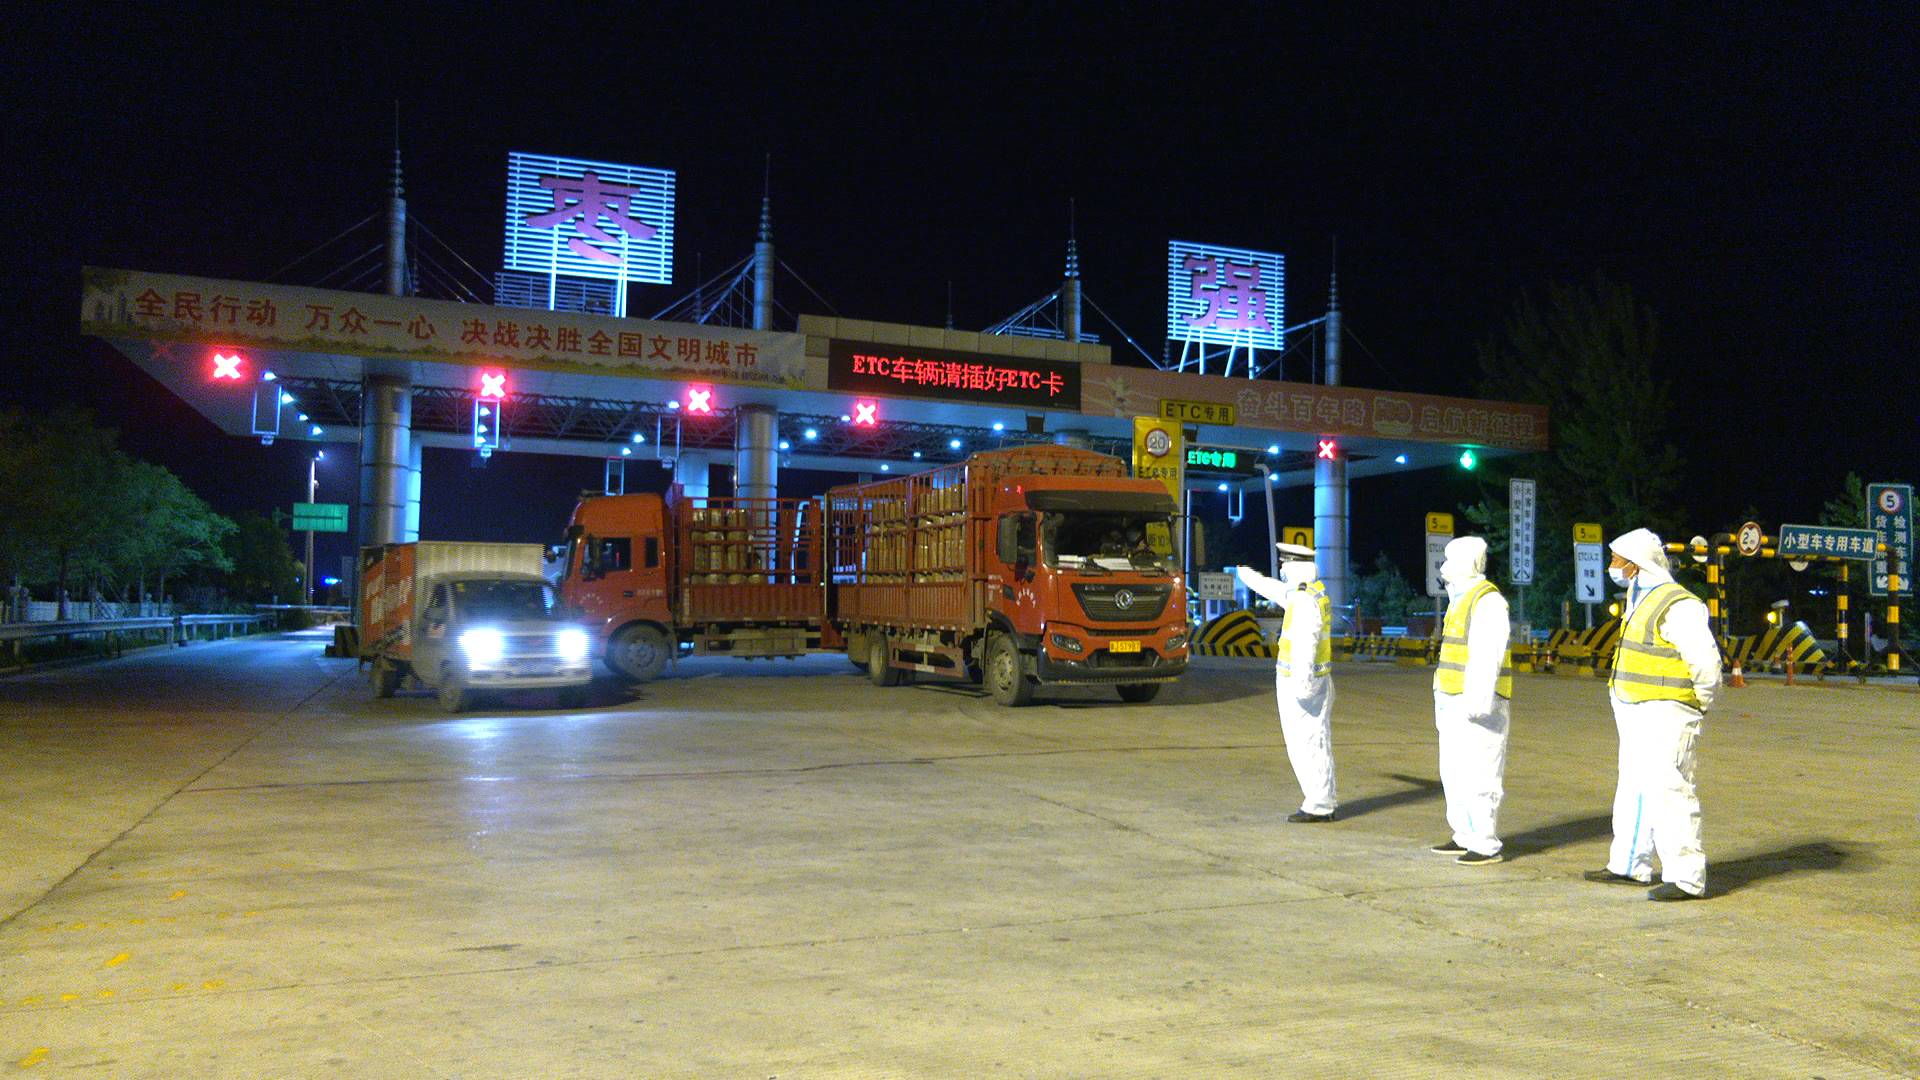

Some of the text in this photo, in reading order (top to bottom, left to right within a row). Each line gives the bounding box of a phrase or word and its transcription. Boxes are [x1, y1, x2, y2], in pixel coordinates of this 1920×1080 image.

[525, 168, 658, 265] 枣
[1182, 254, 1273, 333] 强
[135, 287, 760, 367] 全民行动 万众一心 决战决胜全国文明城市
[852, 354, 1064, 397] ETC车辆请插好ETC卡
[1165, 403, 1230, 422] ETC专用
[1149, 436, 1166, 449] 20
[1886, 495, 1896, 508] 5
[1783, 532, 1875, 555] 小型车专用车道
